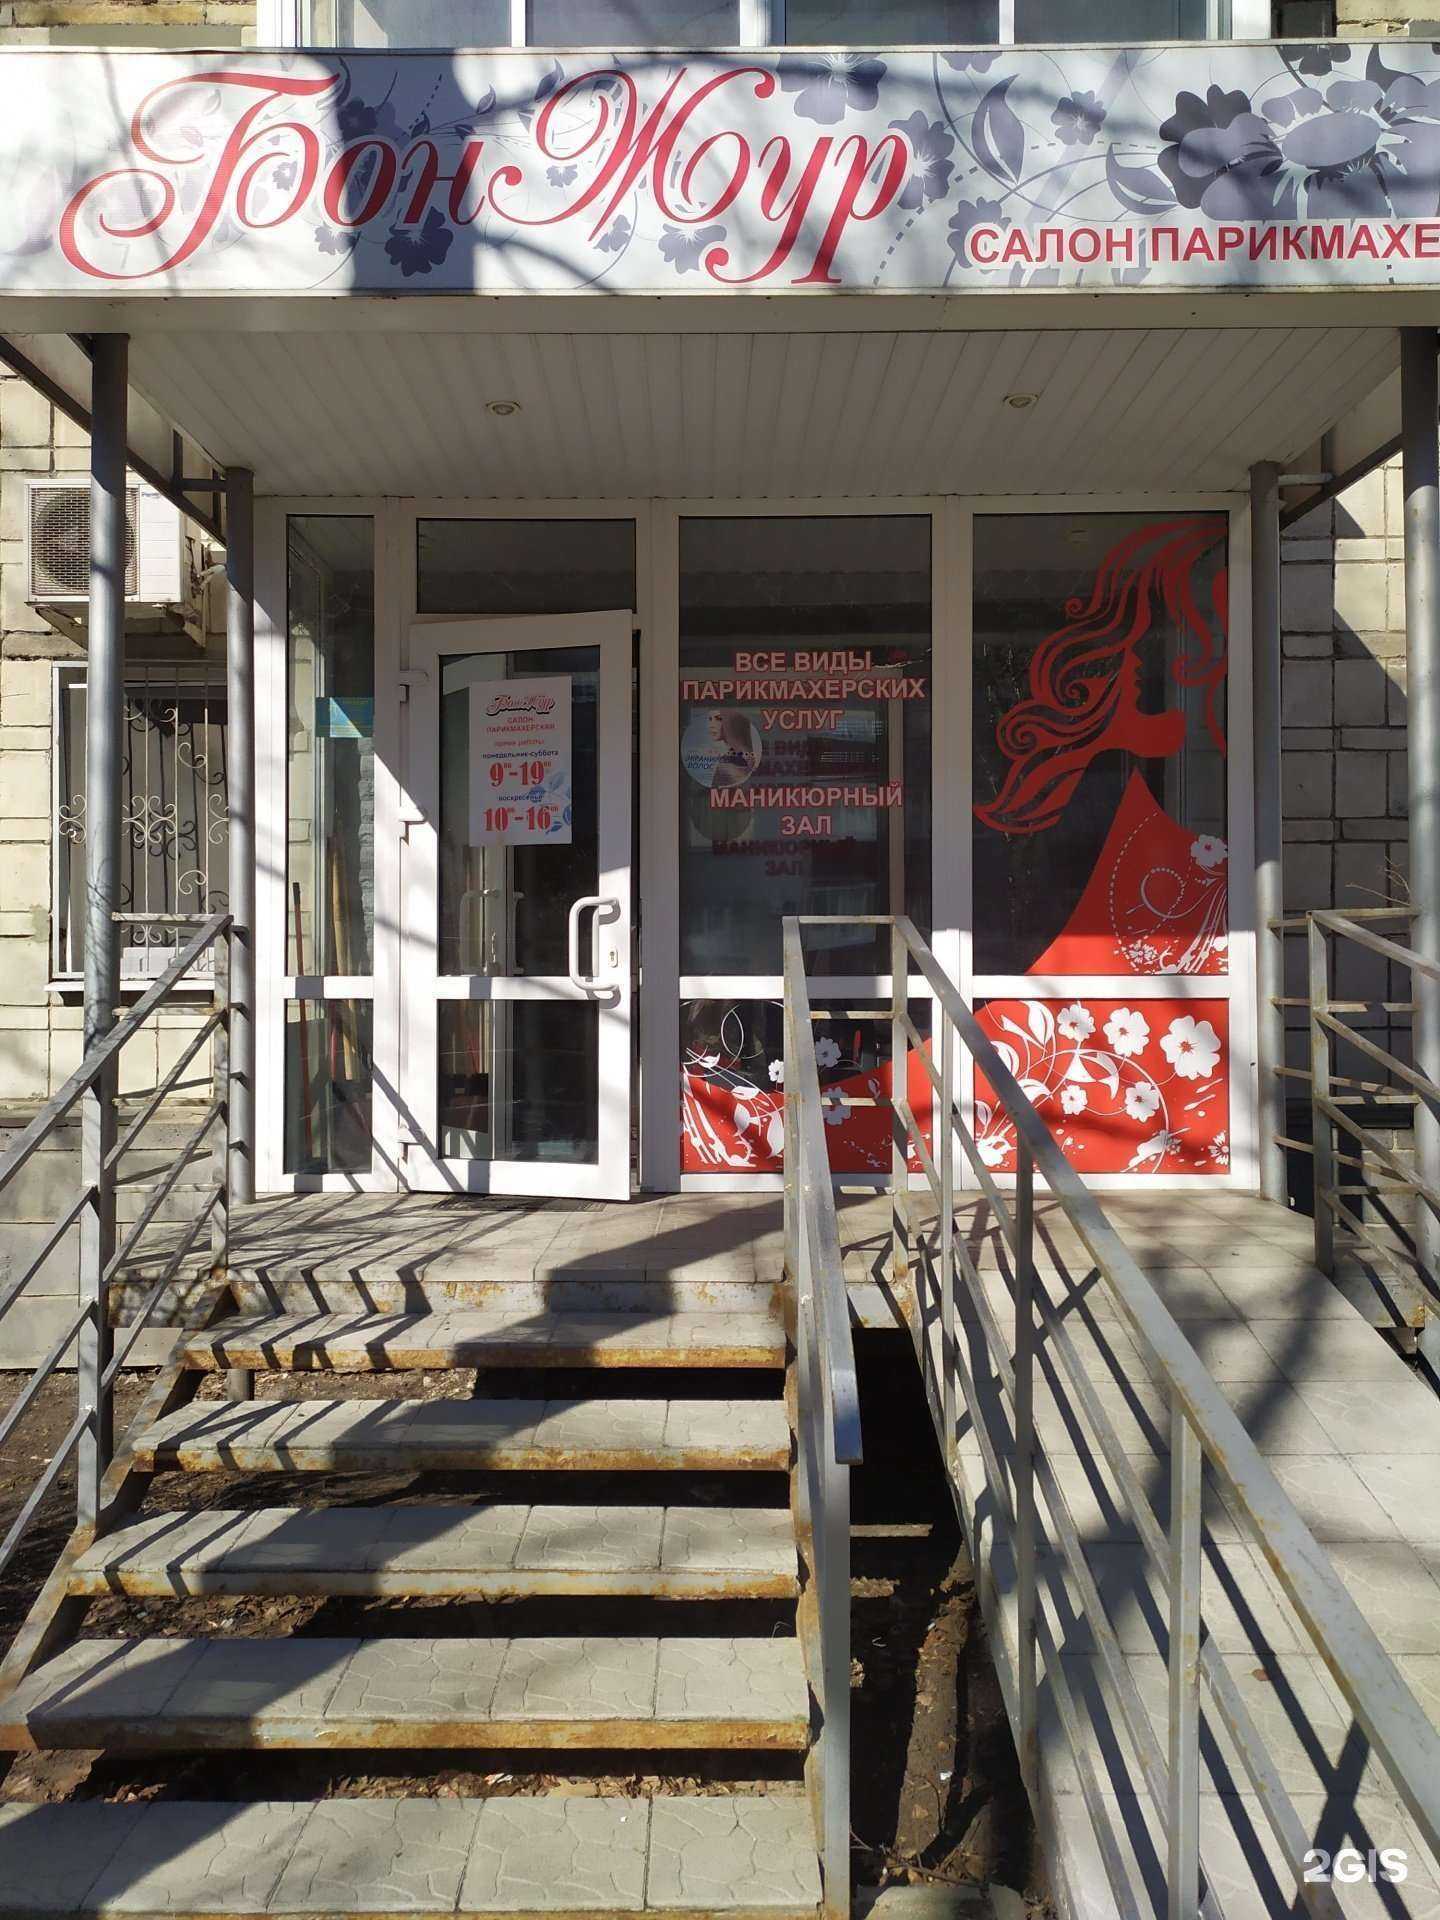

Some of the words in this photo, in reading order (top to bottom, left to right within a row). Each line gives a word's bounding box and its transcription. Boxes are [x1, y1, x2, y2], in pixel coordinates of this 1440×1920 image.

[969, 228, 1134, 263] САЛОН
[1150, 223, 1440, 262] ПАРИКМАХЕ
[735, 651, 787, 673] ВСЕ
[794, 650, 872, 675] ВИДЫ
[682, 678, 927, 701] ПАРИКМАХЕРСКИХ
[507, 716, 534, 725] САЛОН
[762, 708, 844, 731] УСЛУГ
[709, 781, 904, 809] МАНИКЮРНЫЙ
[780, 815, 832, 836] ЗАЛ
